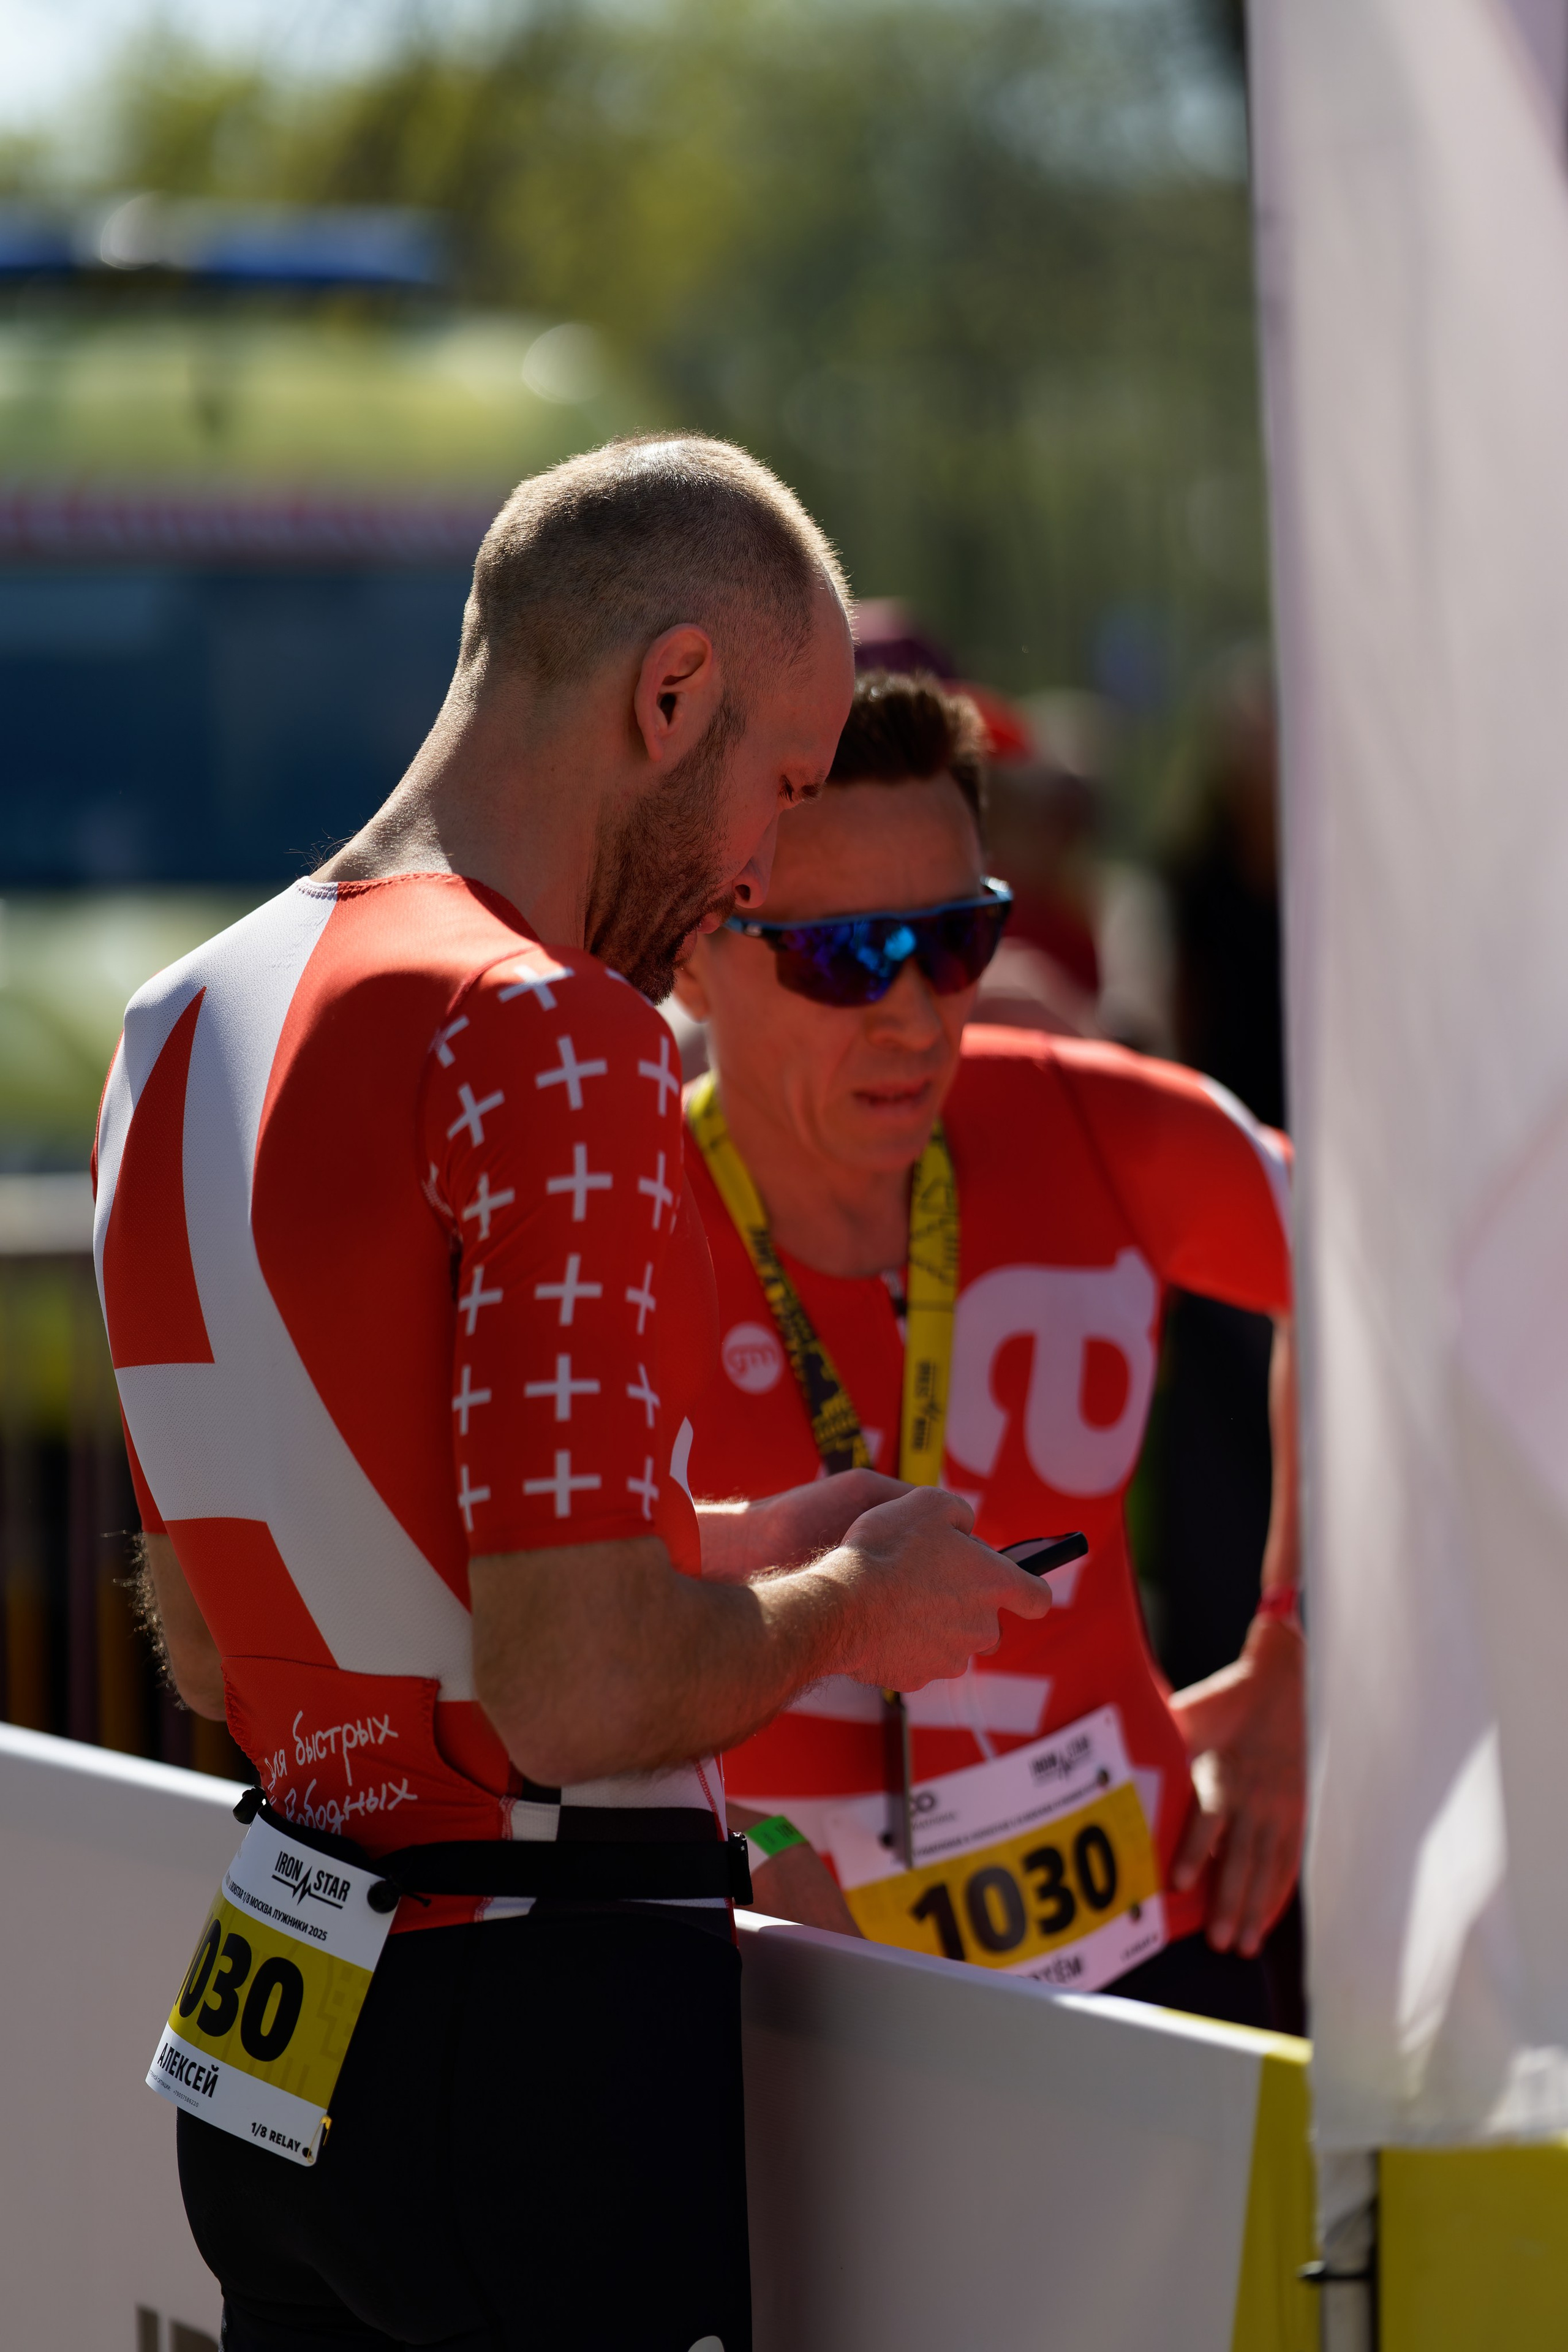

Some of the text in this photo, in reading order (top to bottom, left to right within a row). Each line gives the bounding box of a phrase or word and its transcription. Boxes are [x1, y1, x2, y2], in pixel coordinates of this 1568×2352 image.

[293, 1711, 399, 1787] быстрых
[274, 1850, 351, 1902] IRON STAR
[911, 1823, 1117, 1961] 1030
[249, 1896, 273, 1917] МОСКВА
[272, 1908, 309, 1934] ЛУЖНИКИ
[308, 1925, 328, 1942] 2025
[175, 1917, 304, 2062] 030
[157, 2042, 219, 2098] АЛЕКСЕЙ
[251, 2122, 301, 2153] 1/8 RELAY
